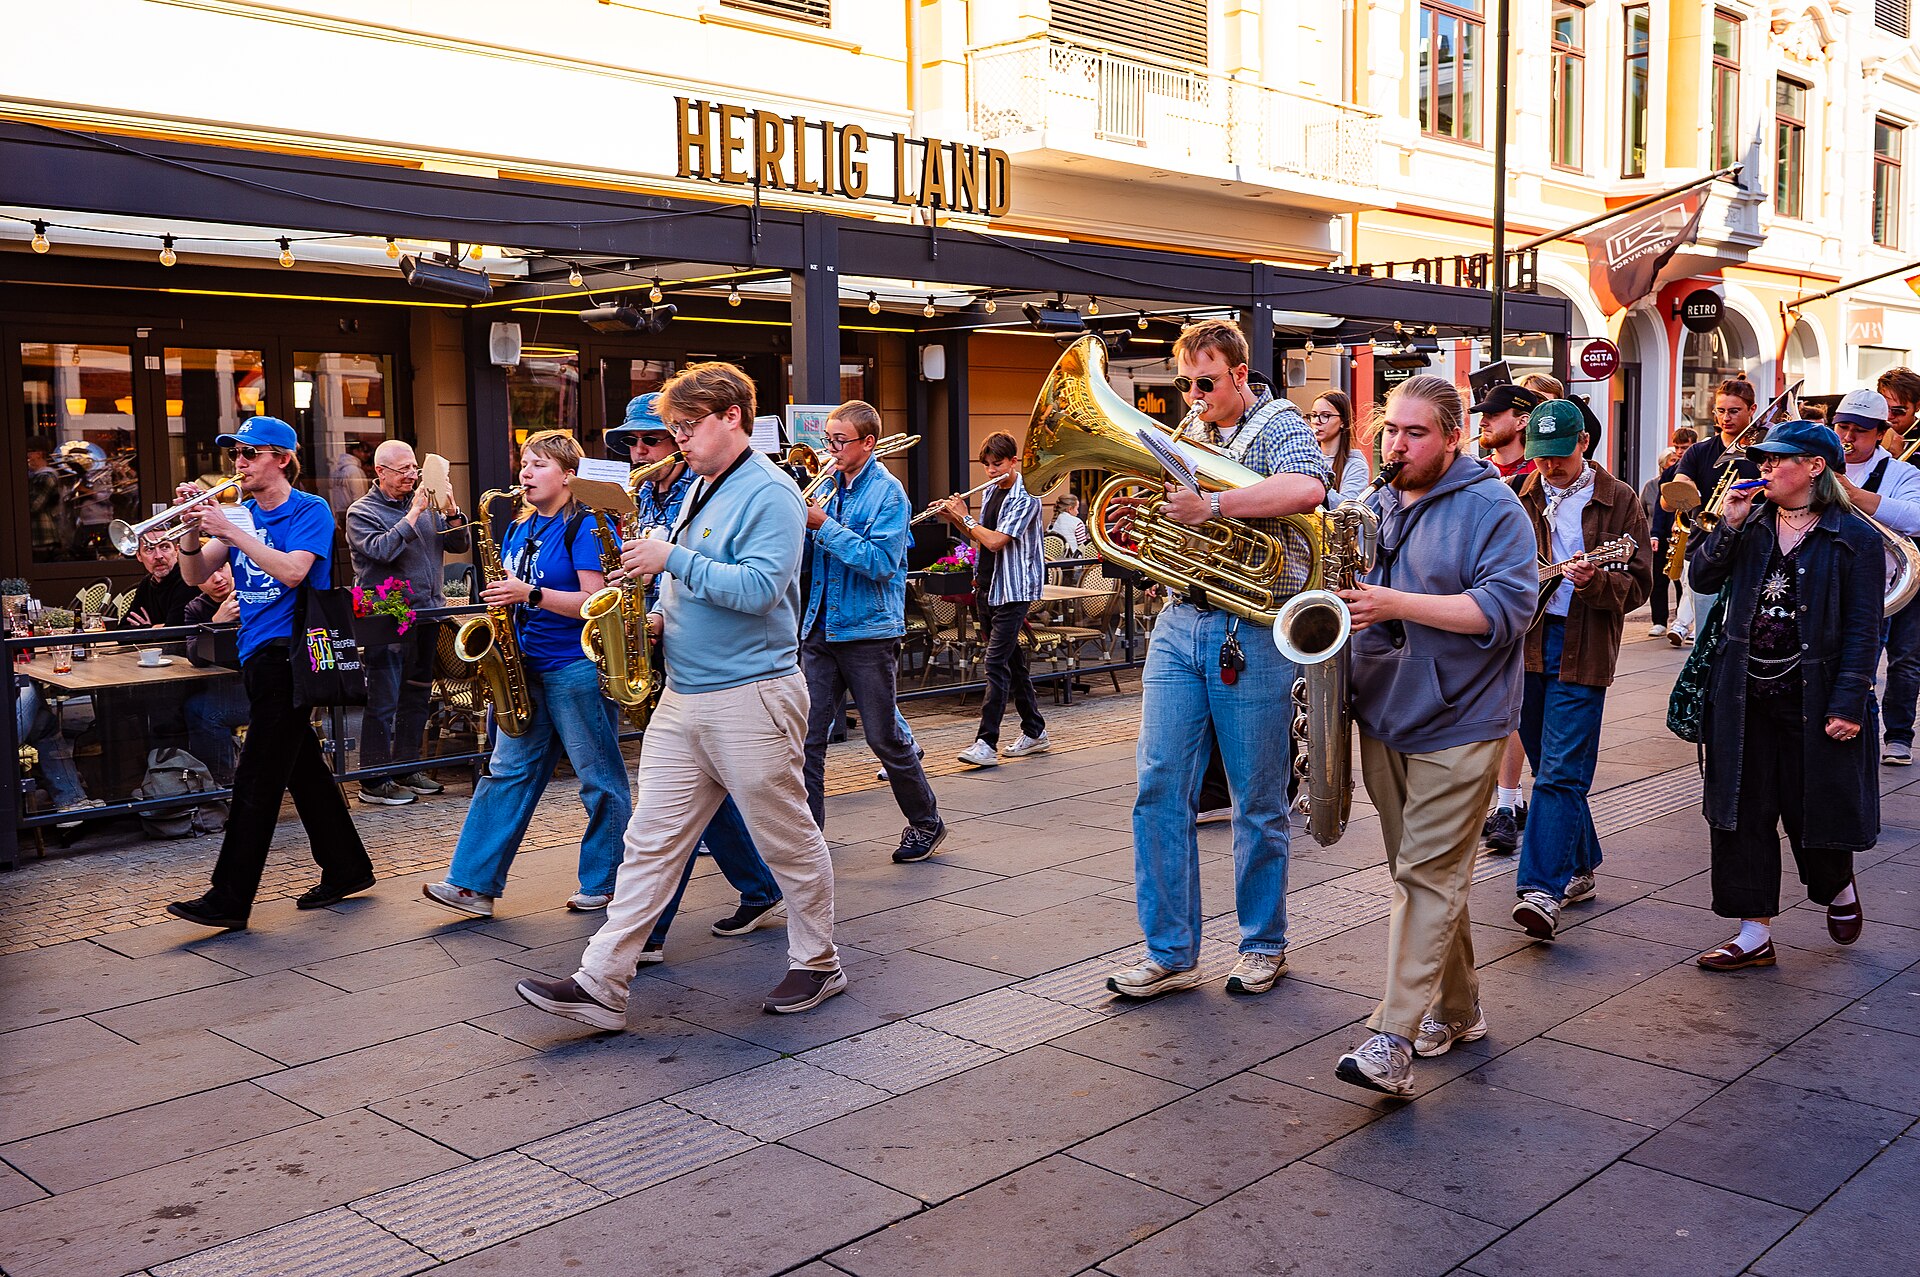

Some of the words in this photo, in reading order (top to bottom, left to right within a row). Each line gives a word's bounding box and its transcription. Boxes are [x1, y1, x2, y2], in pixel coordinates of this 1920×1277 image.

[673, 96, 868, 199] HERLIG
[892, 132, 1011, 218] LAND
[1687, 304, 1717, 315] RETRO
[1583, 353, 1613, 362] COSTA
